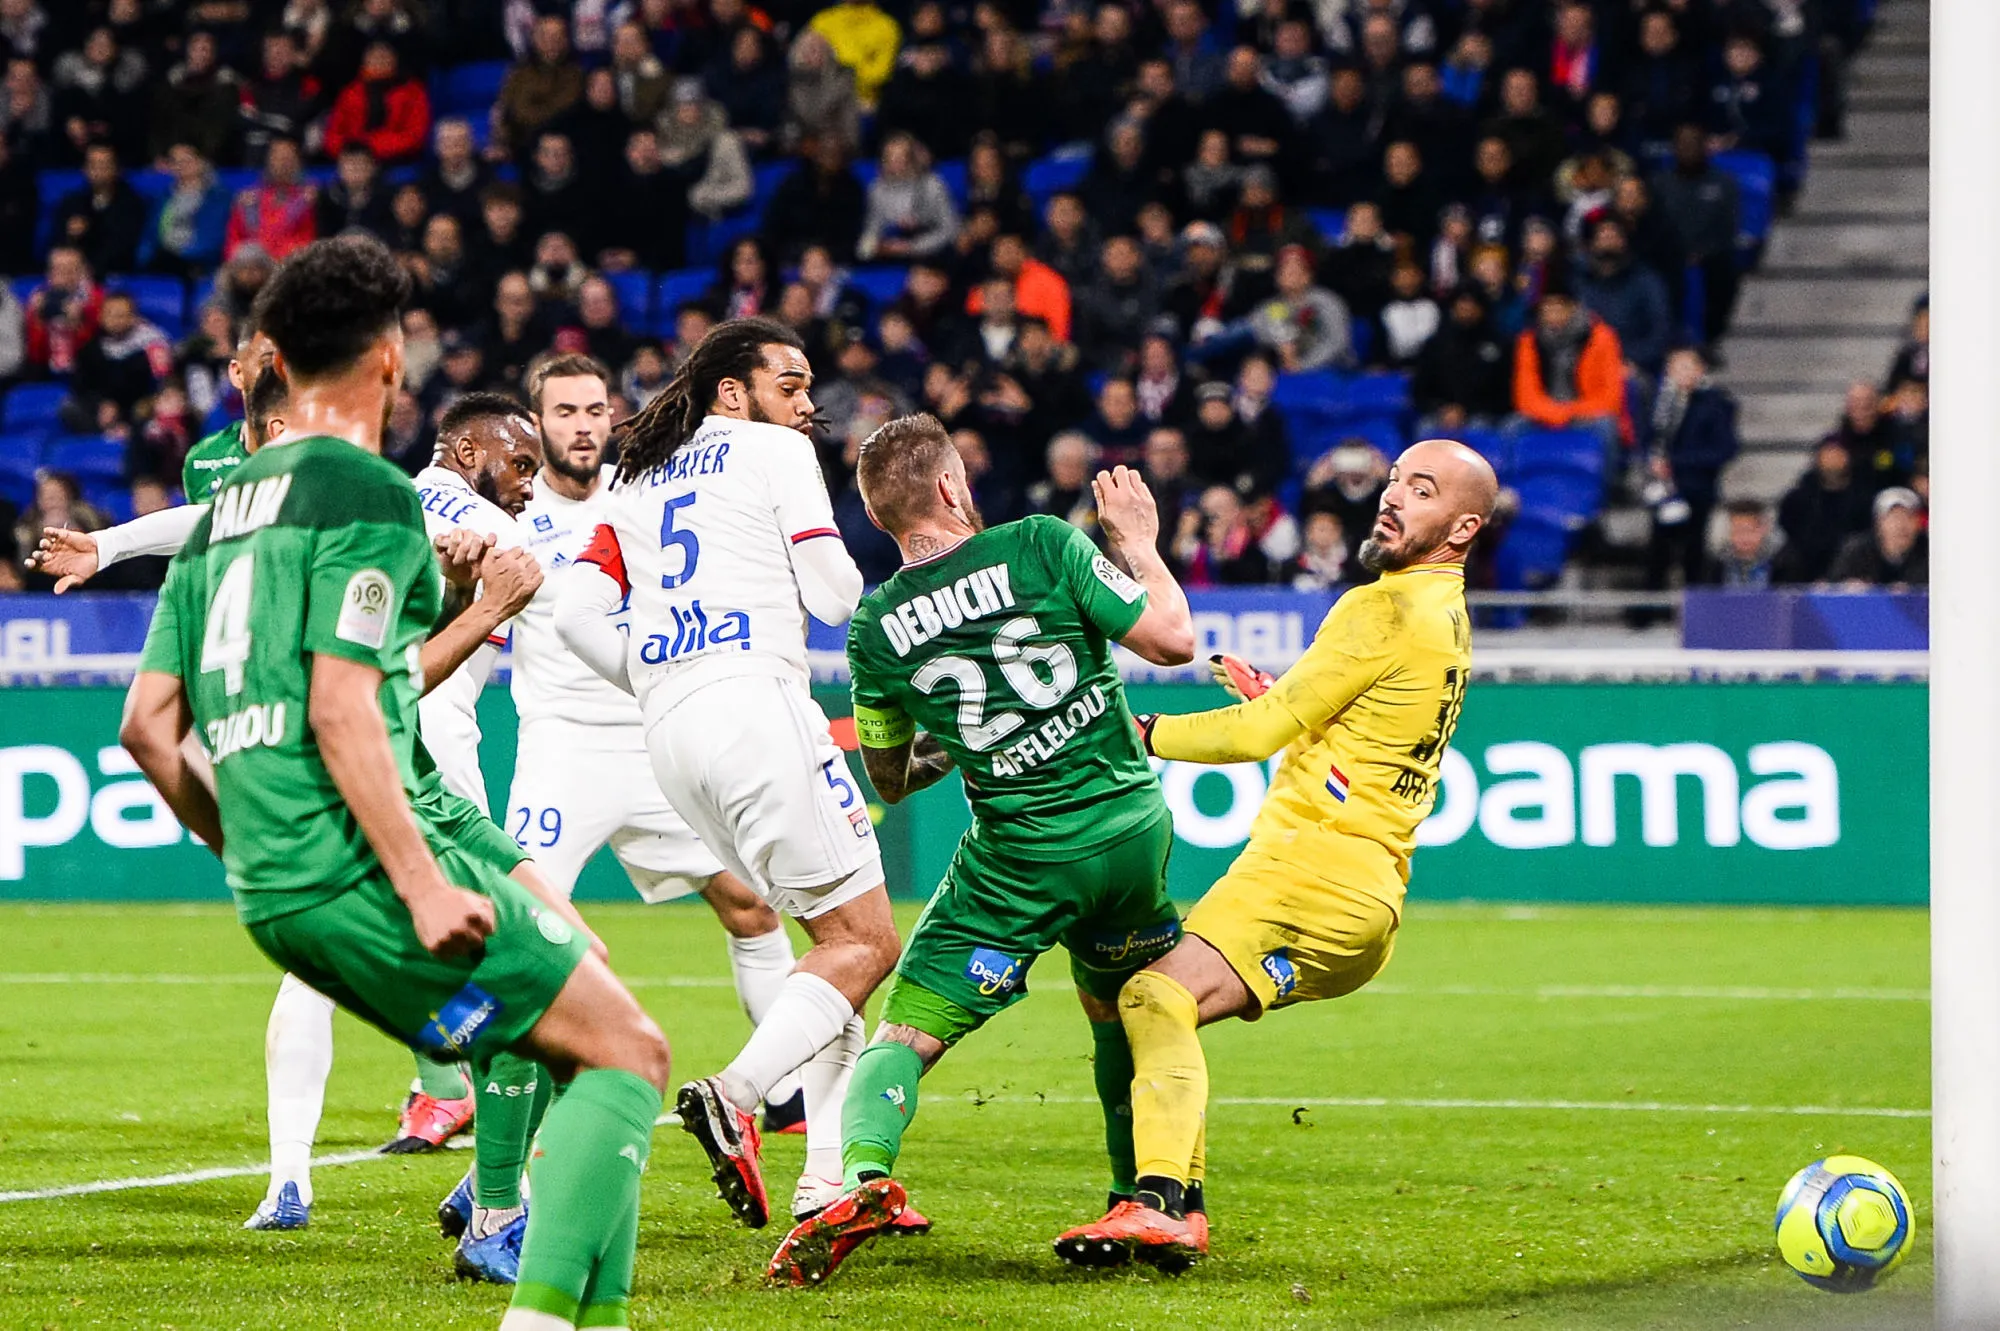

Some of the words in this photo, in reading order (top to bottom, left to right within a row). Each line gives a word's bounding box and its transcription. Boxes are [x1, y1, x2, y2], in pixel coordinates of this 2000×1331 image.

[641, 442, 730, 488] ENAYER
[661, 492, 699, 589] 5
[200, 553, 254, 696] 4
[640, 598, 751, 665] alila
[880, 563, 1017, 658] DEBUCHY
[910, 615, 1077, 752] 26
[991, 684, 1107, 777] AFFLELOU
[822, 758, 854, 808] 5
[515, 806, 562, 848] 29
[485, 1081, 538, 1097] ASS
